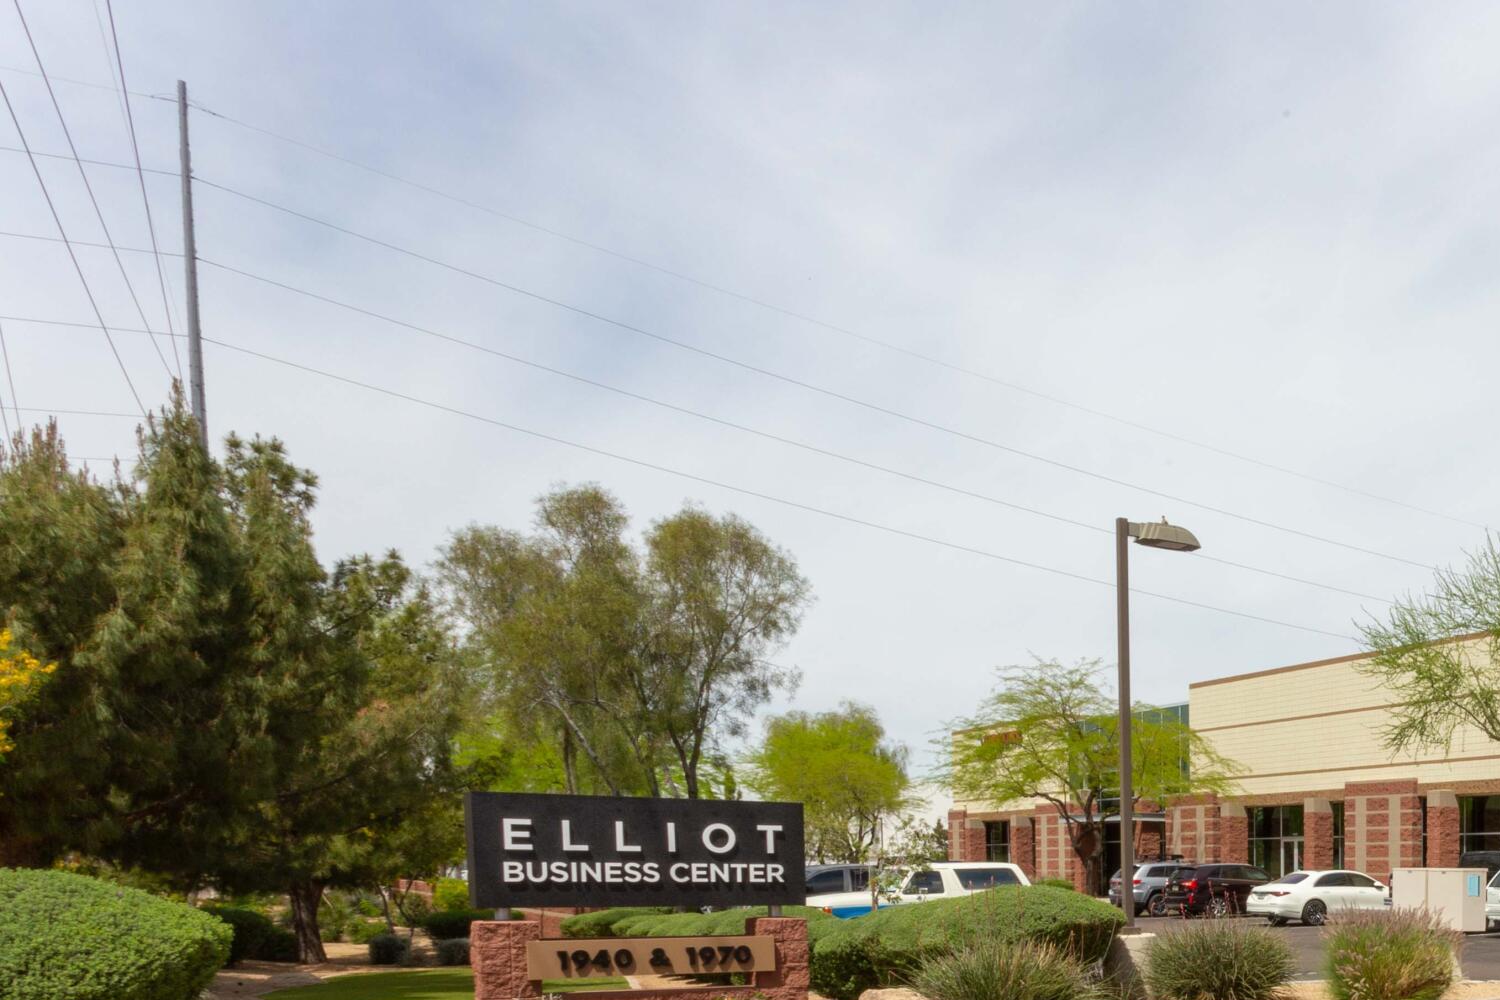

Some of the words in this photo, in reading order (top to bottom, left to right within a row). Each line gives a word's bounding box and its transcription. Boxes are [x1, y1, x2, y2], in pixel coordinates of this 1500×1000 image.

[502, 817, 784, 854] ELLIOT
[502, 861, 660, 883] BUSINESS
[669, 862, 785, 883] CENTER
[557, 949, 633, 970] 1940
[650, 947, 671, 968] &
[686, 945, 752, 966] 1970
